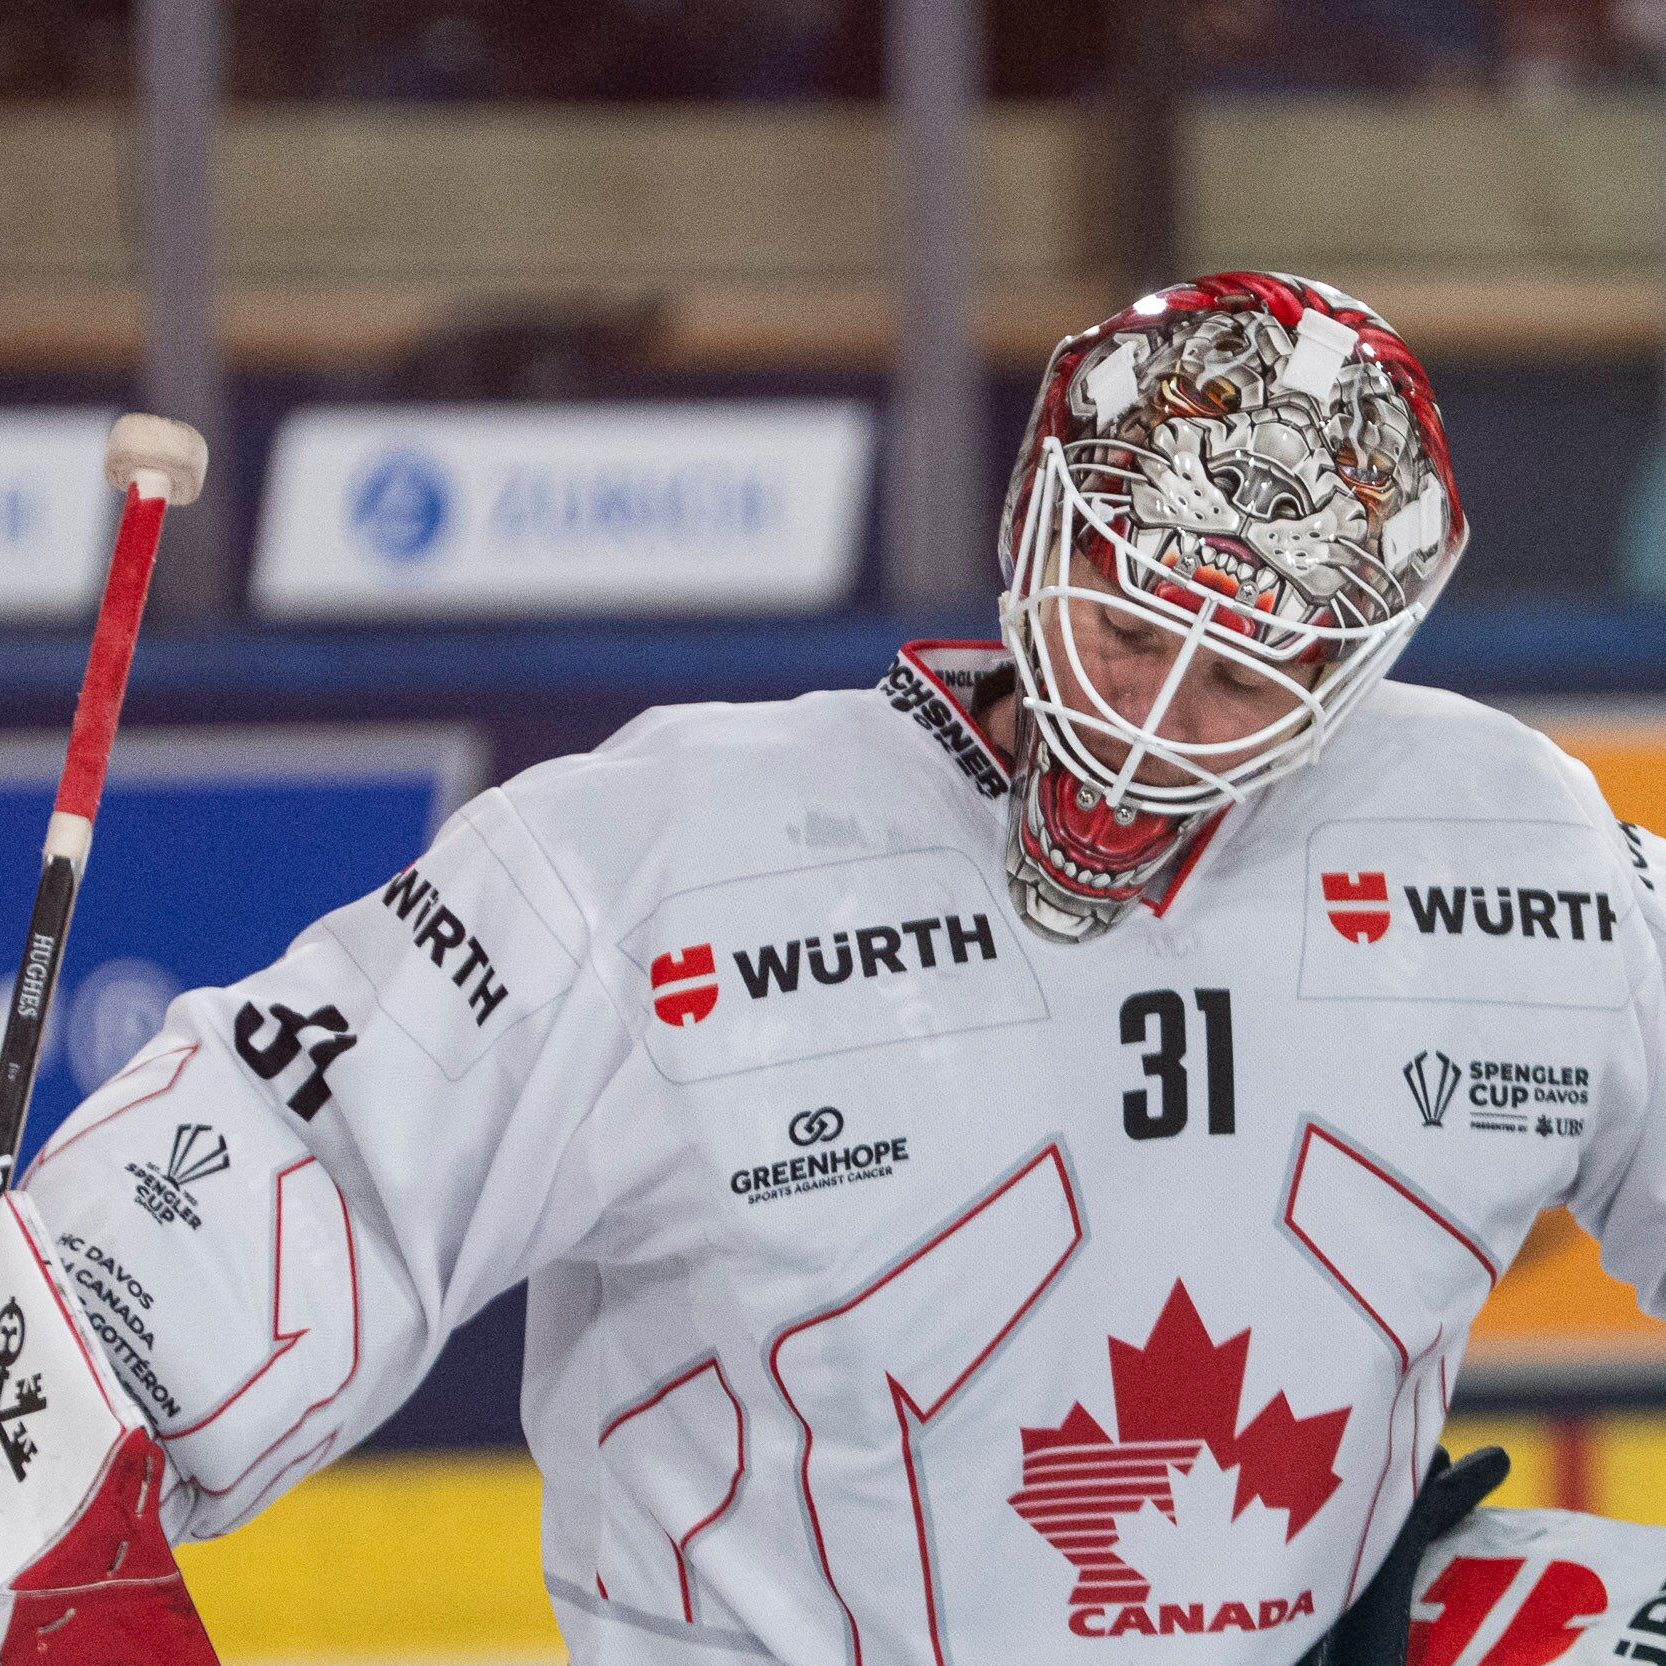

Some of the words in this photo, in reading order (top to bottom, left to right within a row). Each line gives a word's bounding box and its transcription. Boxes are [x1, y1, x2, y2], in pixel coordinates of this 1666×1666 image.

[733, 913, 999, 1000] WÜRTH
[1119, 988, 1236, 1140] 31
[1469, 1060, 1589, 1087] SPENGLER
[1469, 1083, 1529, 1108] CUP
[1534, 1087, 1589, 1105] DAVOS
[731, 1137, 910, 1195] GREENHOPE
[748, 1186, 793, 1205] SPORTS
[795, 1175, 845, 1193] AGAINST
[848, 1166, 893, 1183] CANCER
[125, 1163, 202, 1231] SPENGLER
[136, 1184, 175, 1223] CUP
[85, 1246, 154, 1310] DAVOS
[76, 1269, 155, 1351] CANADA
[1068, 1590, 1315, 1638] CANADA
